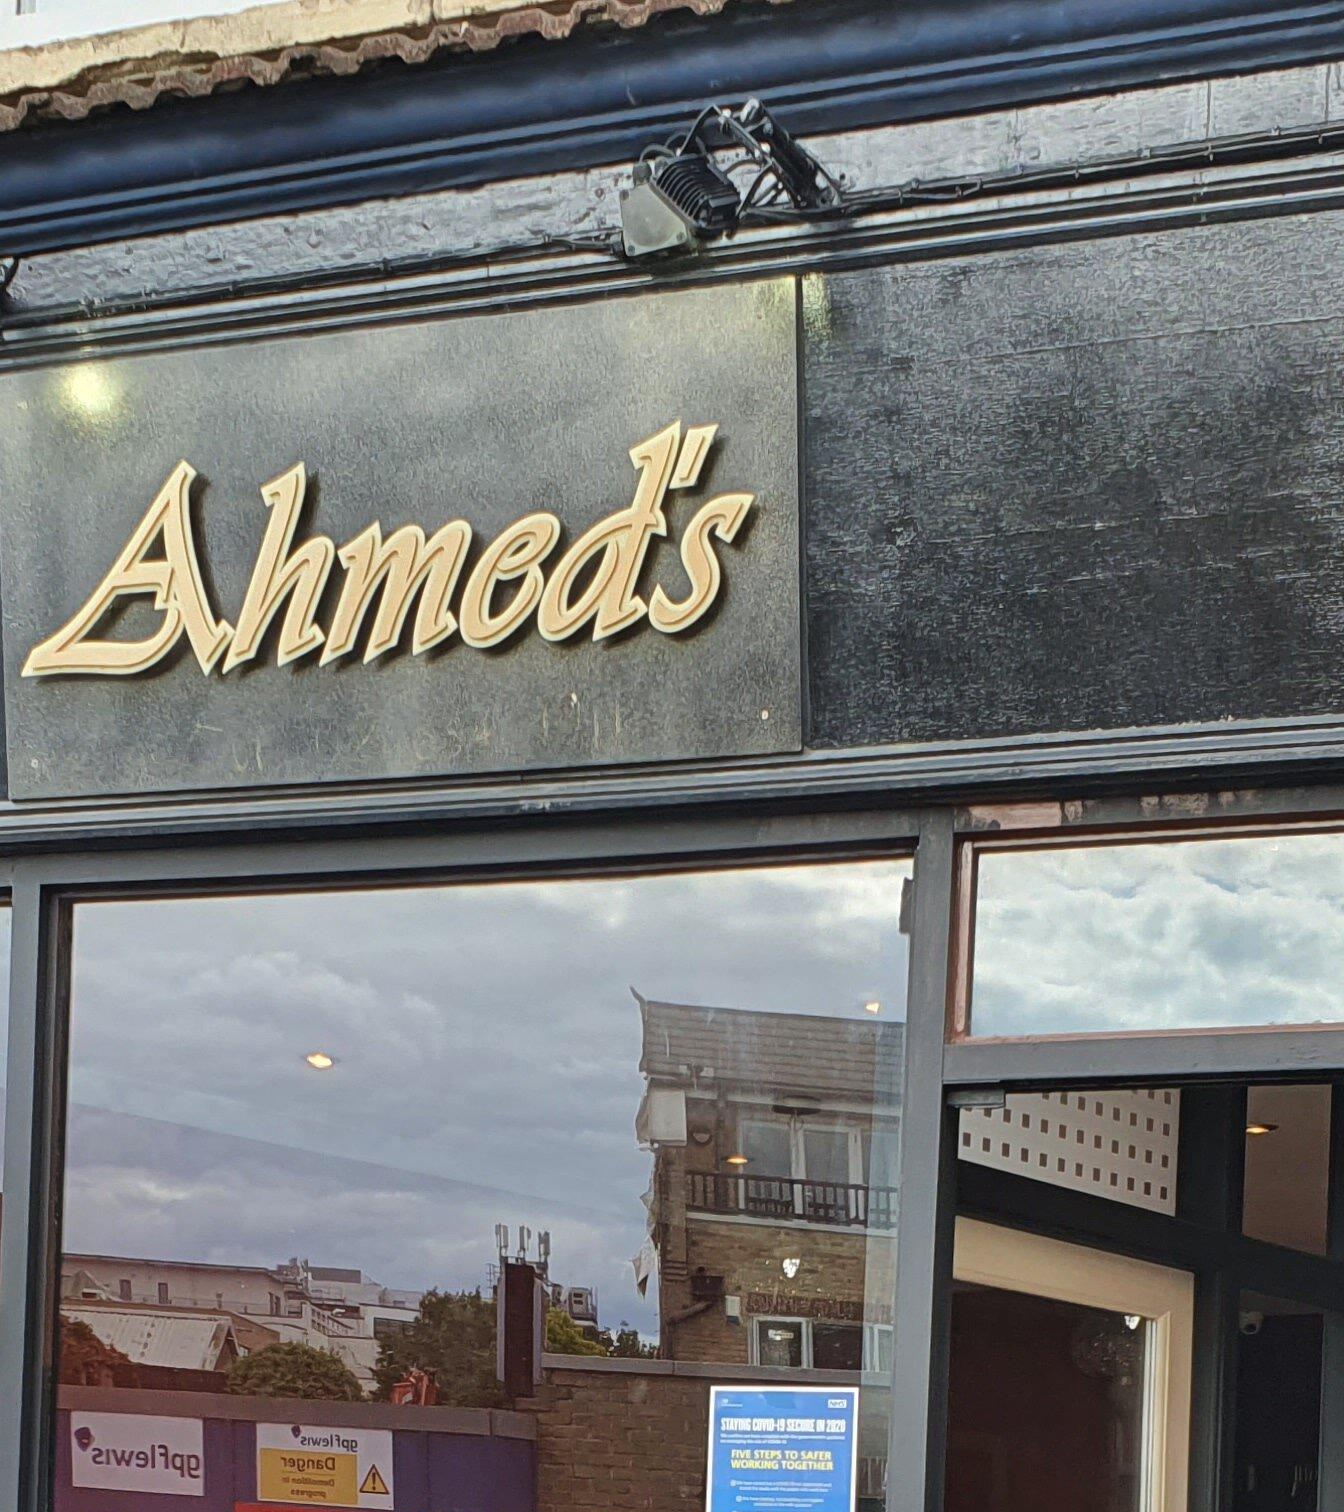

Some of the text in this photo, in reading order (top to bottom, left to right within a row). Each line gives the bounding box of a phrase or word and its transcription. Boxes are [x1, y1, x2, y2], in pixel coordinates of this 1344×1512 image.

[20, 419, 755, 678] Ahmed's
[752, 1418, 785, 1431] COVID-19
[731, 1449, 832, 1460] FIVE STEPS TO SAFER
[731, 1459, 833, 1471] WORKING TOGETHER
